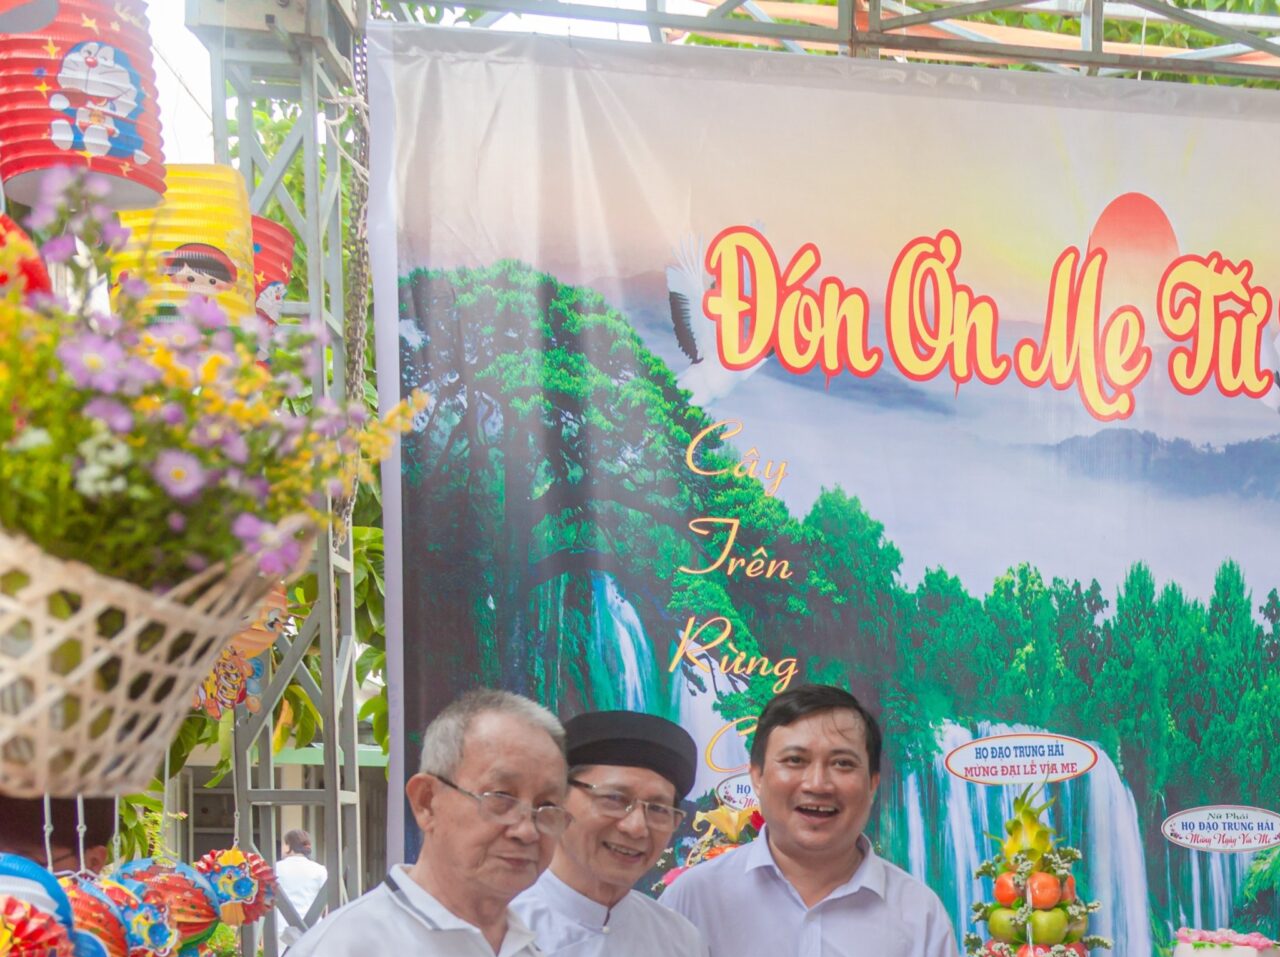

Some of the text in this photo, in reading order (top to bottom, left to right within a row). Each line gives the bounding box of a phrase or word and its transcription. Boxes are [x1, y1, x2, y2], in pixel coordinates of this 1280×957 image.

[704, 225, 881, 374] Đón
[886, 229, 1011, 386] Ơn
[1014, 246, 1152, 422] Mẹ
[685, 418, 790, 497] Cây
[678, 517, 794, 580] Trên
[669, 616, 798, 694] Rừng
[964, 764, 999, 778] MỪNG
[1001, 764, 1020, 778] ĐẠI
[1023, 760, 1037, 775] LỄ
[975, 740, 1064, 762] HỌ ĐẠO TRUNG HẢI
[1181, 819, 1274, 832] HỌ ĐẠO TRUNG HẢI
